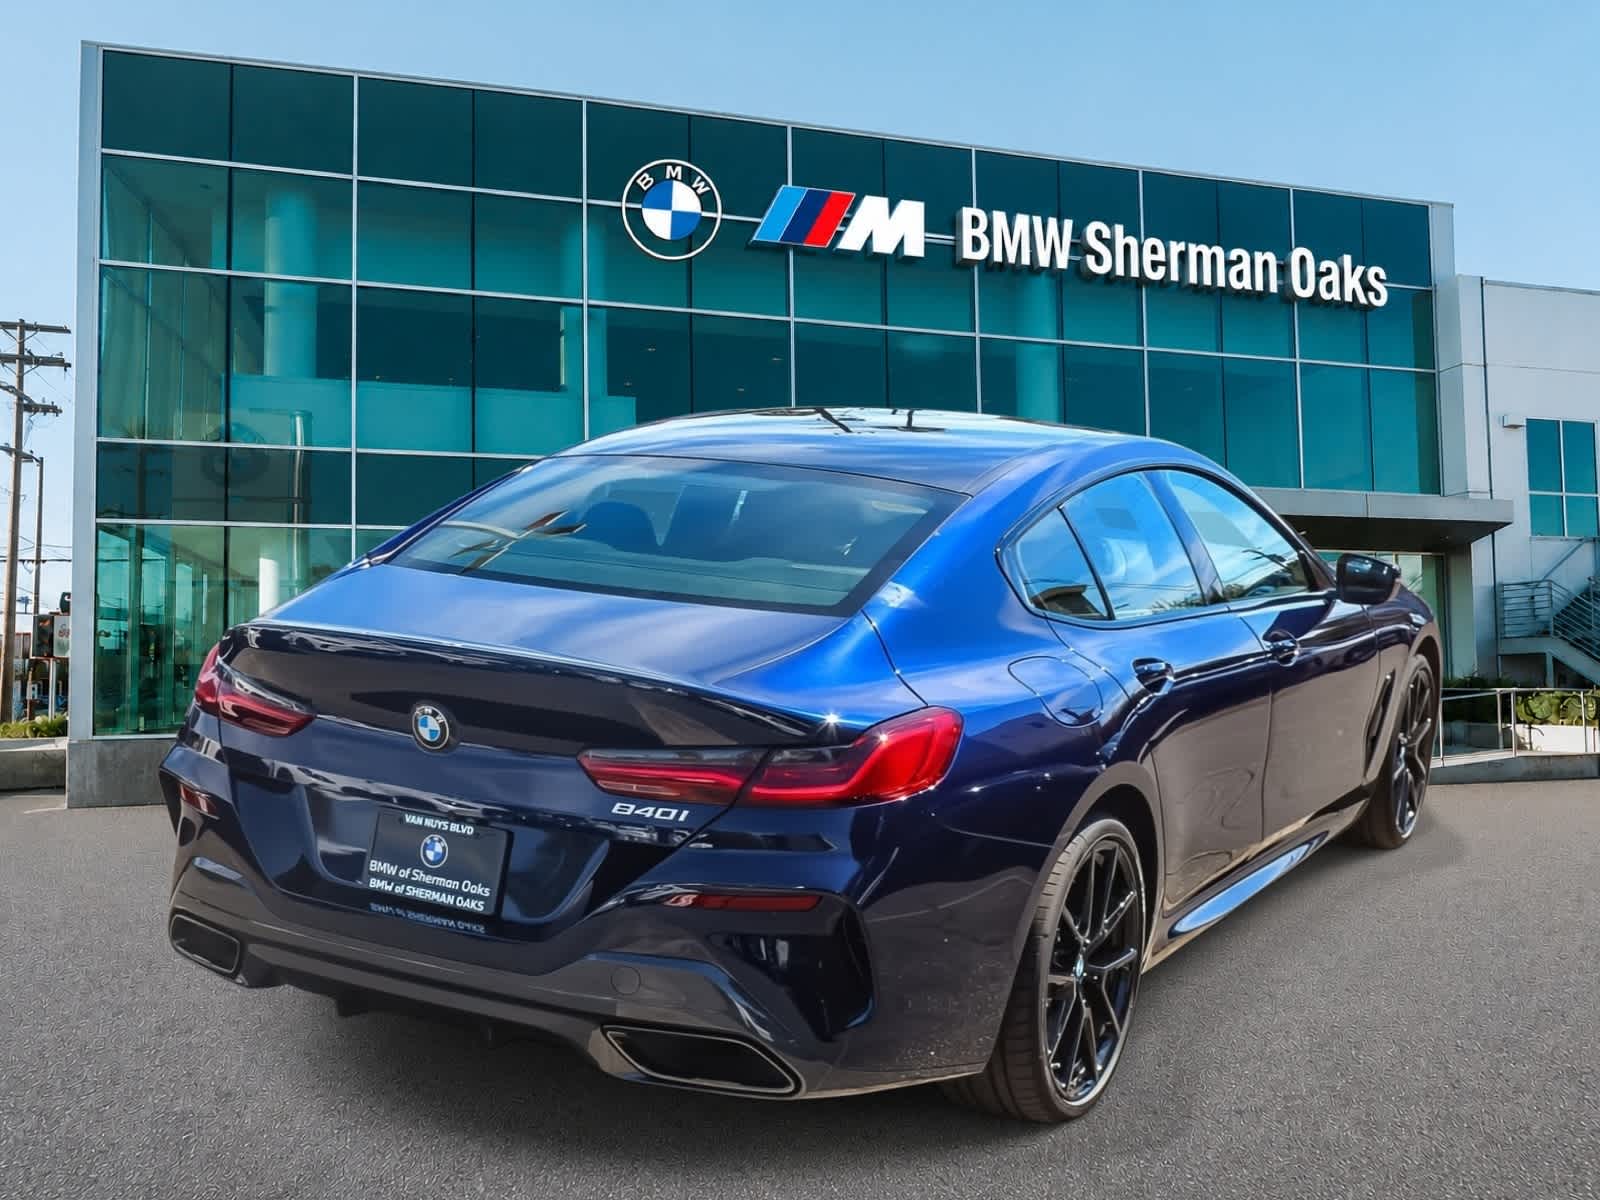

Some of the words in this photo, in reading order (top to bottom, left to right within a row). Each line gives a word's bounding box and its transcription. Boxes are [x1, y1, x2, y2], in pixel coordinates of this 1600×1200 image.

[636, 164, 712, 197] BMW
[834, 194, 925, 258] M
[958, 206, 1073, 270] BMW
[1082, 220, 1279, 294] Sherman
[1288, 246, 1389, 308] Oaks
[404, 813, 423, 826] VAN
[423, 817, 449, 831] NUYS
[449, 822, 474, 836] BLVD
[369, 859, 398, 876] BMW
[399, 867, 411, 880] of
[411, 868, 459, 891] Sherman
[461, 880, 491, 897] Oaks
[369, 878, 394, 891] BMW
[394, 884, 405, 895] of
[404, 885, 455, 905] SHERMAN
[455, 896, 485, 912] OAKS
